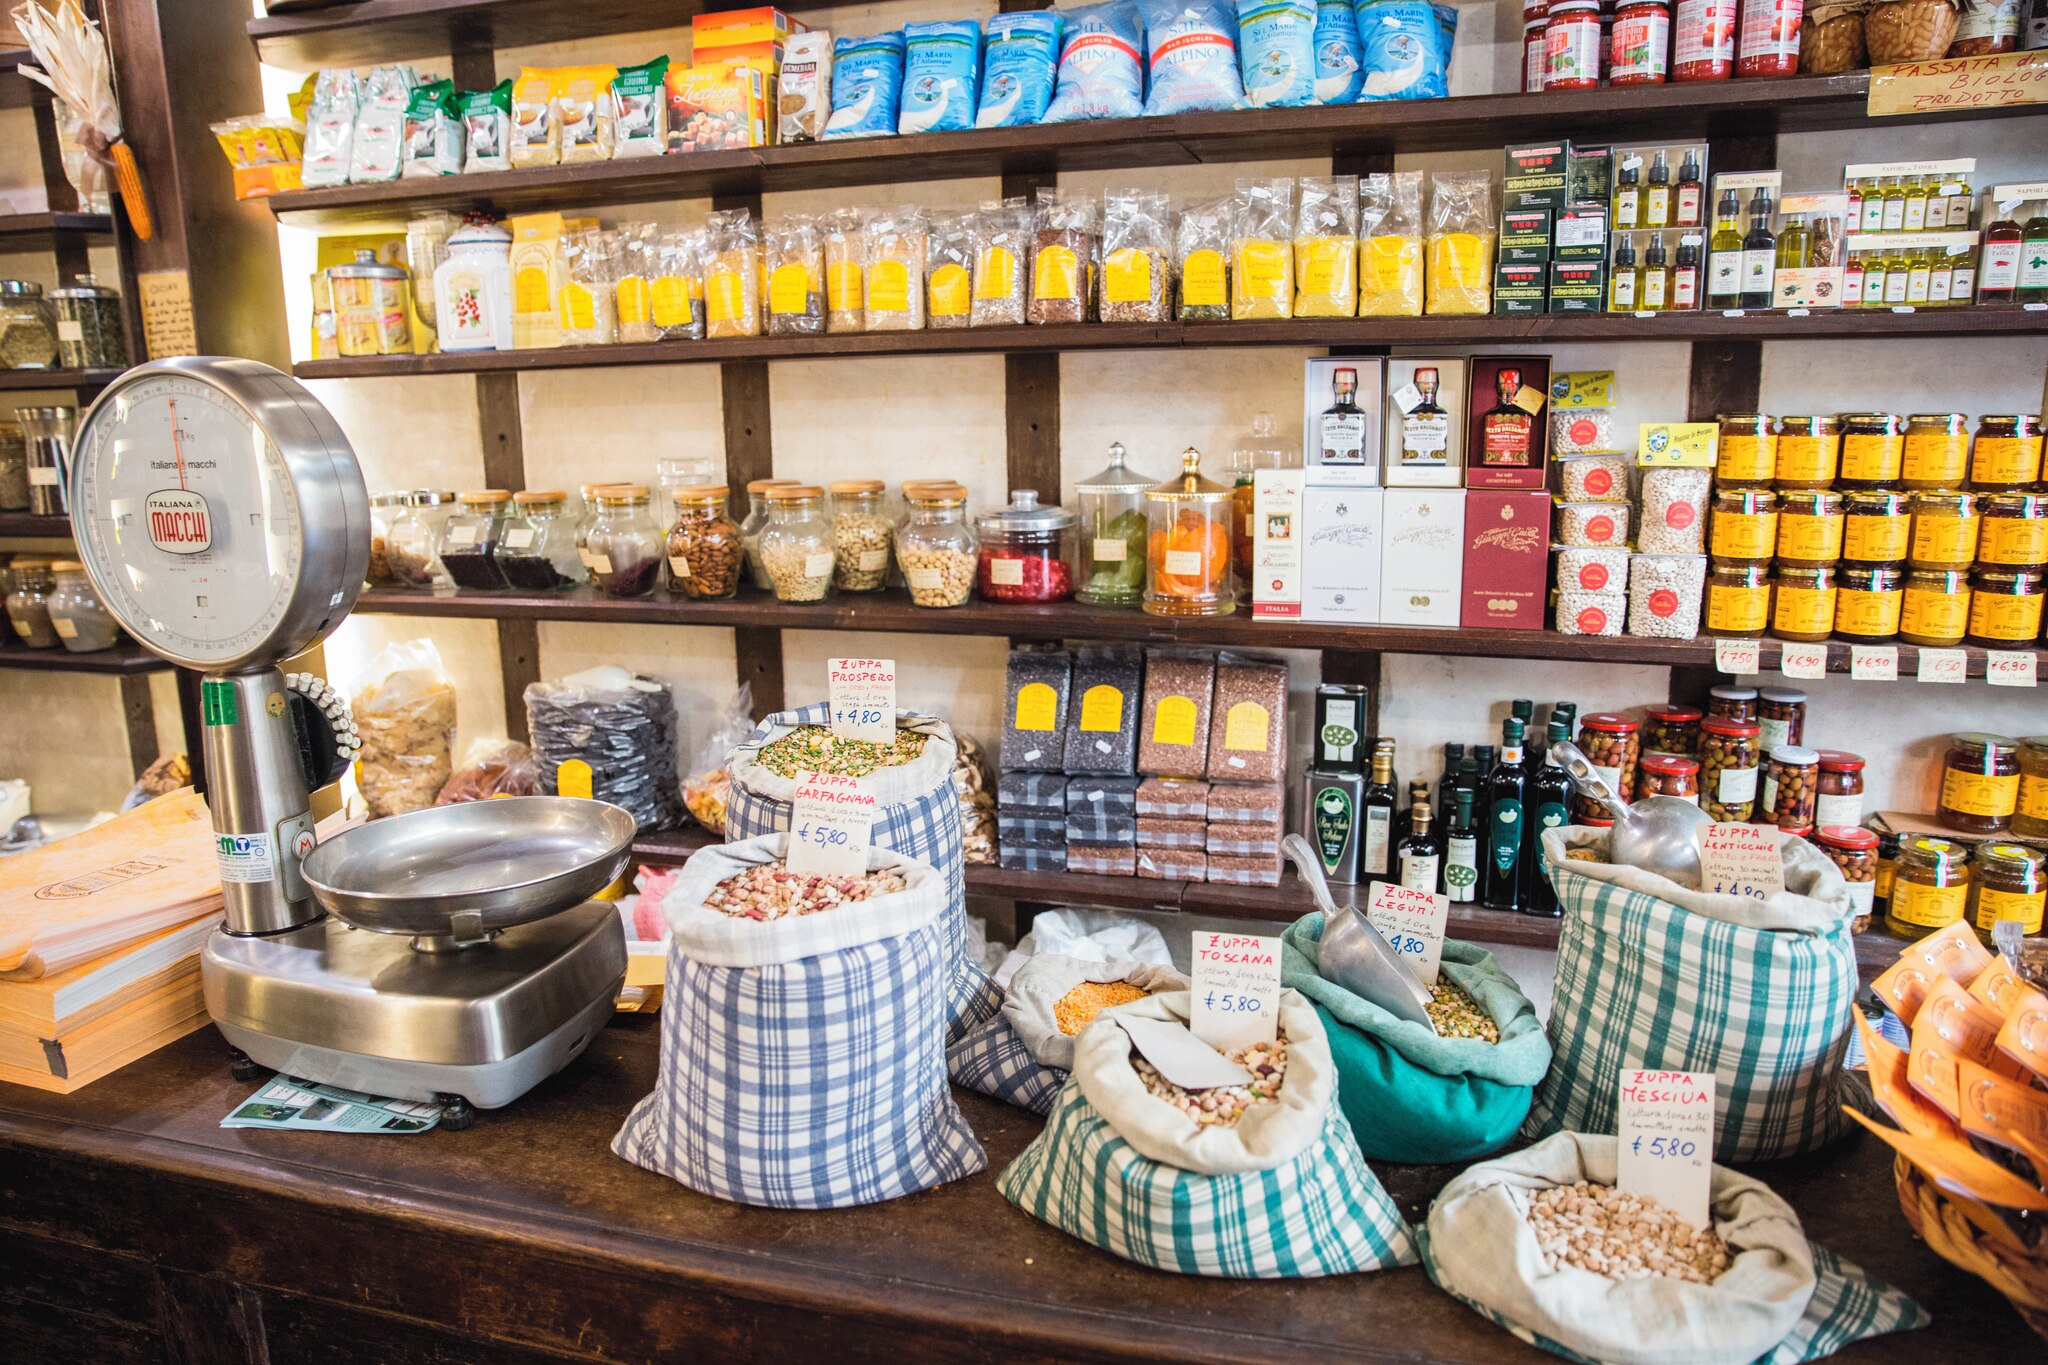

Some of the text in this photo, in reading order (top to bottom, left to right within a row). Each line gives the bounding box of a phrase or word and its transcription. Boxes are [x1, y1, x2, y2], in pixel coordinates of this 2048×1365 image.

[1394, 8, 1424, 18] MARIN
[925, 50, 953, 59] MARIN
[1164, 46, 1220, 66] ALPINO
[855, 59, 880, 68] MARIN
[1888, 53, 2036, 78] PASSATA di
[1913, 89, 2025, 108] PRODOTTO
[150, 459, 217, 469] italiana macchi
[151, 512, 207, 542] MACCHI
[1257, 559, 1296, 568] BALSAMICO
[1719, 640, 1756, 650] ACACIA
[839, 660, 882, 669] ZUPPA
[1795, 655, 1820, 668] 6,90
[1865, 657, 1890, 669] 6,50
[1999, 660, 2027, 673] 6,90
[832, 671, 894, 682] PROSPERO
[836, 709, 882, 727] € 4,80
[808, 773, 857, 788] ZUPPA
[795, 786, 875, 806] GARFAGNANA
[798, 822, 848, 848] € 5,80
[1707, 824, 1760, 838] ZUPPA
[1384, 885, 1434, 905] ZUPPA
[1209, 934, 1260, 949] ZUPPA
[1391, 934, 1425, 955] 4,80
[1199, 949, 1273, 966] TOSCANA
[1204, 990, 1261, 1013] € 5,80
[1633, 1071, 1693, 1085] ZUPPA
[1632, 1135, 1696, 1159] € 5,80
